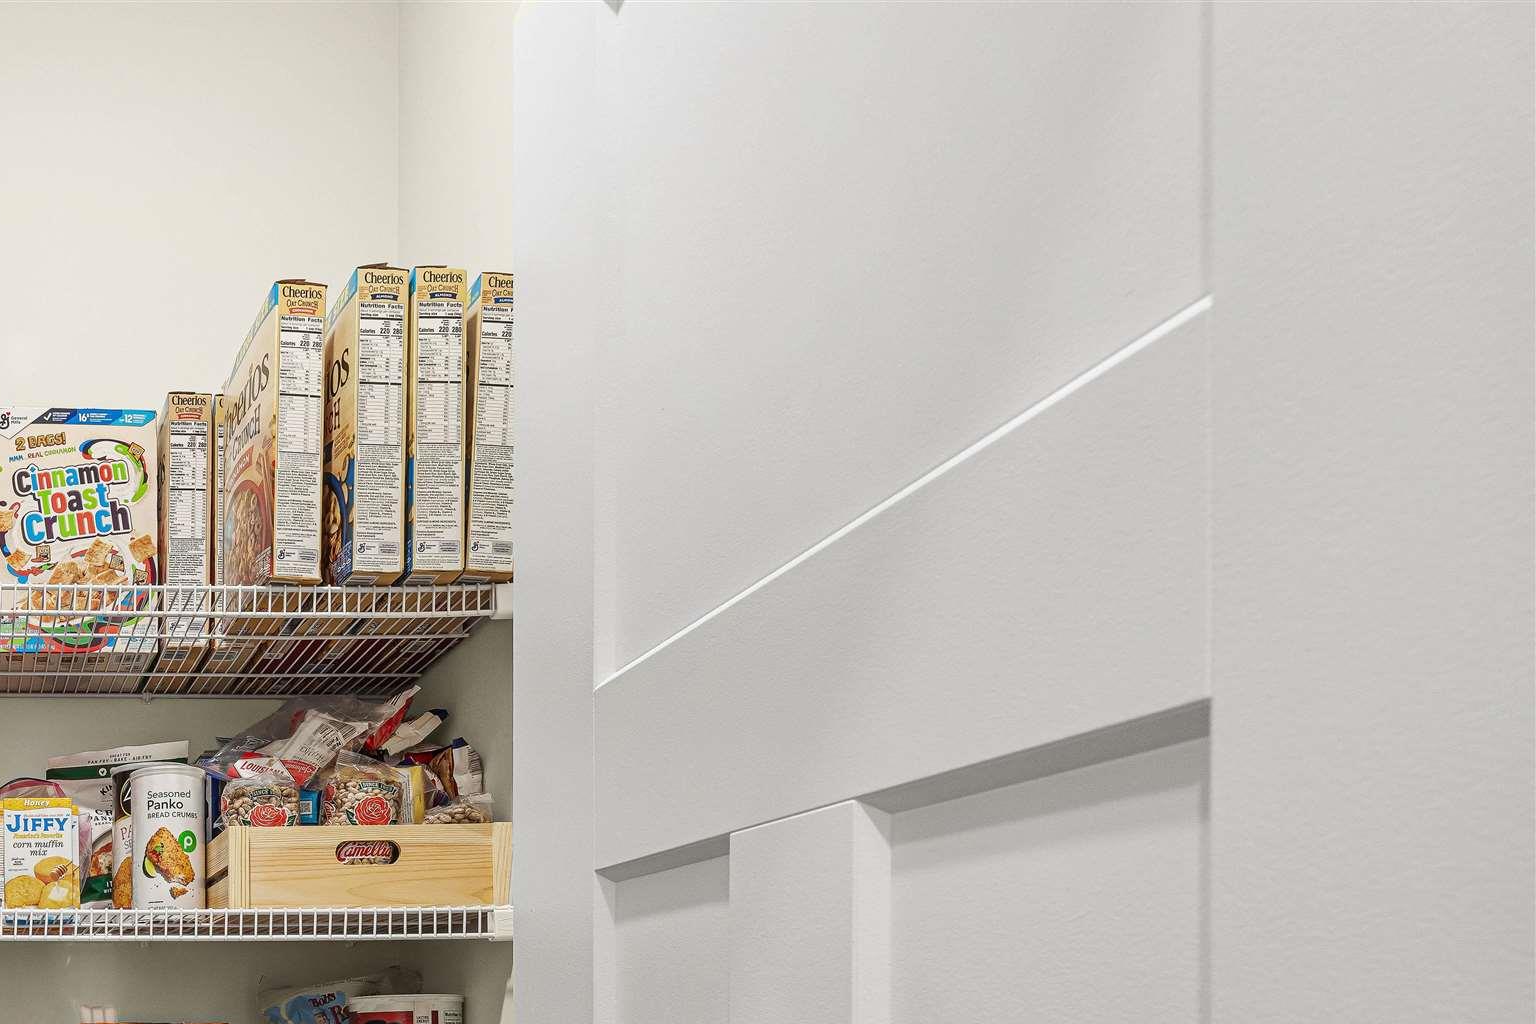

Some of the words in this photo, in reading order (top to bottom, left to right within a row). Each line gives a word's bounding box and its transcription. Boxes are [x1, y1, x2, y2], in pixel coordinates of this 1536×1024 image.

[365, 272, 403, 285] Cheerios
[423, 271, 463, 283] Cheerios
[283, 285, 322, 299] Cheerios
[172, 396, 206, 406] Cheerios
[16, 461, 127, 493] Cinnamon
[37, 483, 109, 515] Toast
[25, 500, 130, 542] Crunch
[147, 790, 191, 799] Seasoned
[24, 799, 50, 807] Honey
[147, 800, 184, 810] Panko
[147, 812, 170, 820] BREAD
[34, 839, 64, 848] muffin
